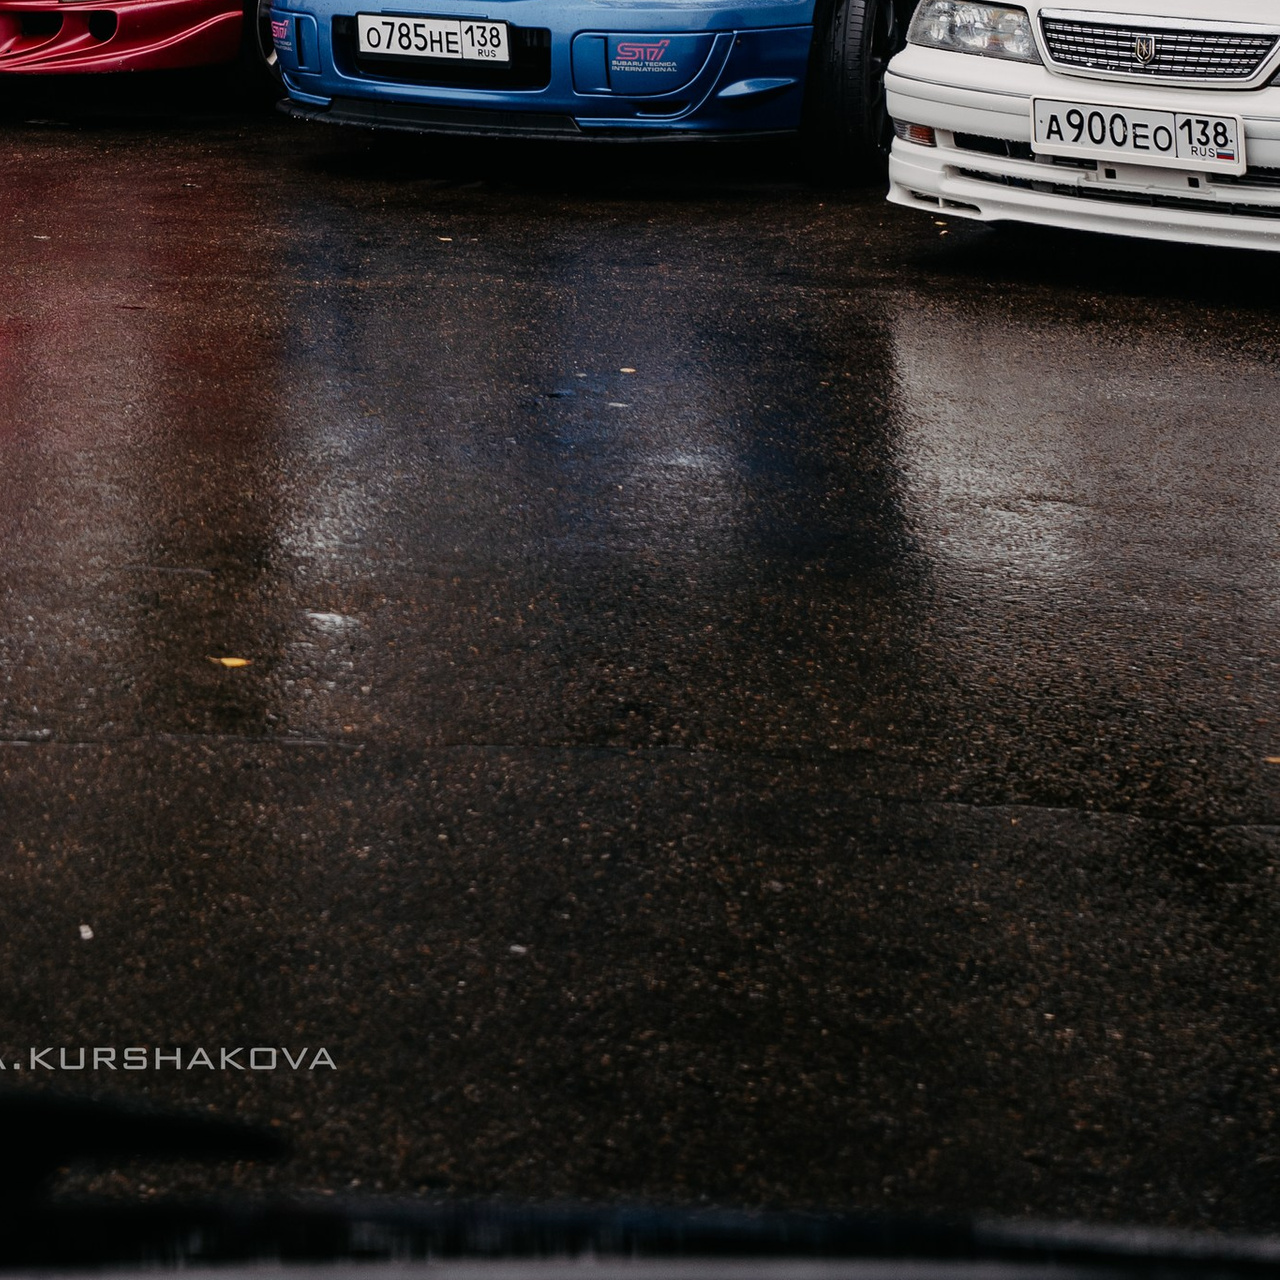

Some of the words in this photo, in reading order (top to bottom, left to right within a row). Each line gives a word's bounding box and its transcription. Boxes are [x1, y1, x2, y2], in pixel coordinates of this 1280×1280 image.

[366, 21, 460, 54] О785НЕ
[464, 25, 502, 49] 138
[477, 49, 497, 58] RUS
[1046, 109, 1172, 151] А900ЕО
[1179, 118, 1228, 147] 138
[1191, 145, 1216, 158] RUS
